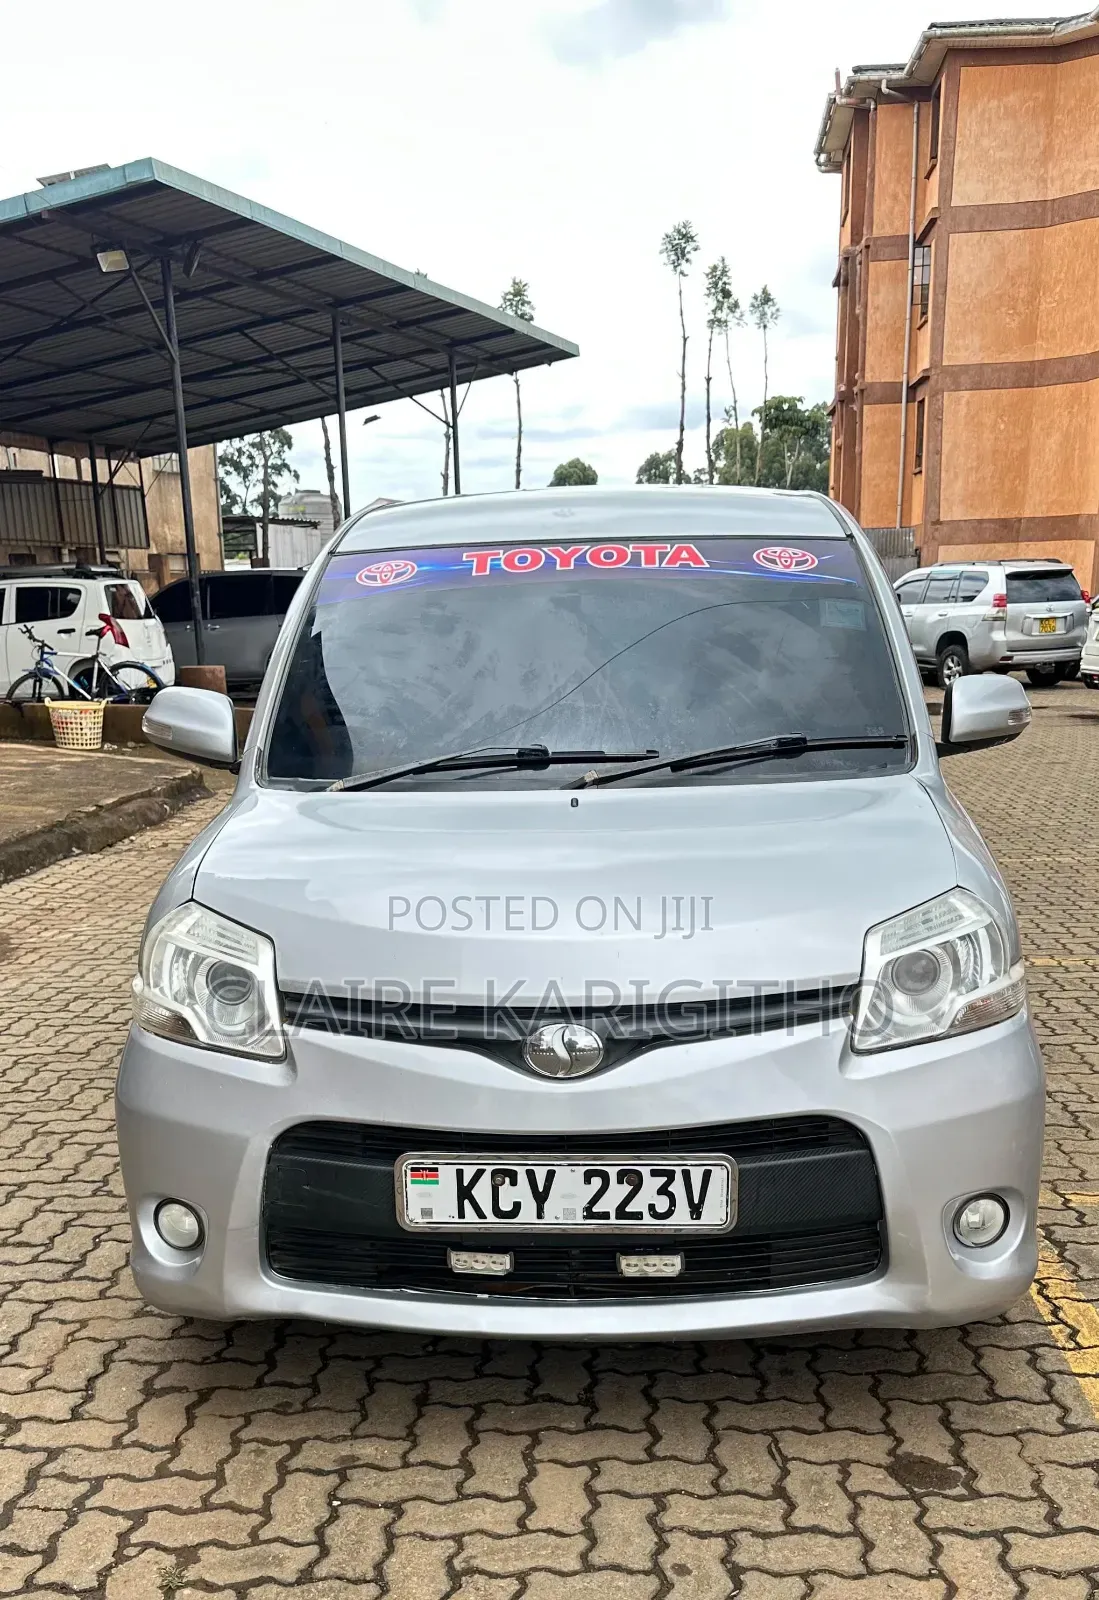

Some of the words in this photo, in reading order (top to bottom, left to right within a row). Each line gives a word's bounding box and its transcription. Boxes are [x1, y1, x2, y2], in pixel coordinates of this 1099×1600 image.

[463, 544, 710, 576] TOYOTA
[455, 1168, 557, 1220] KCY
[582, 1168, 713, 1221] 223V
